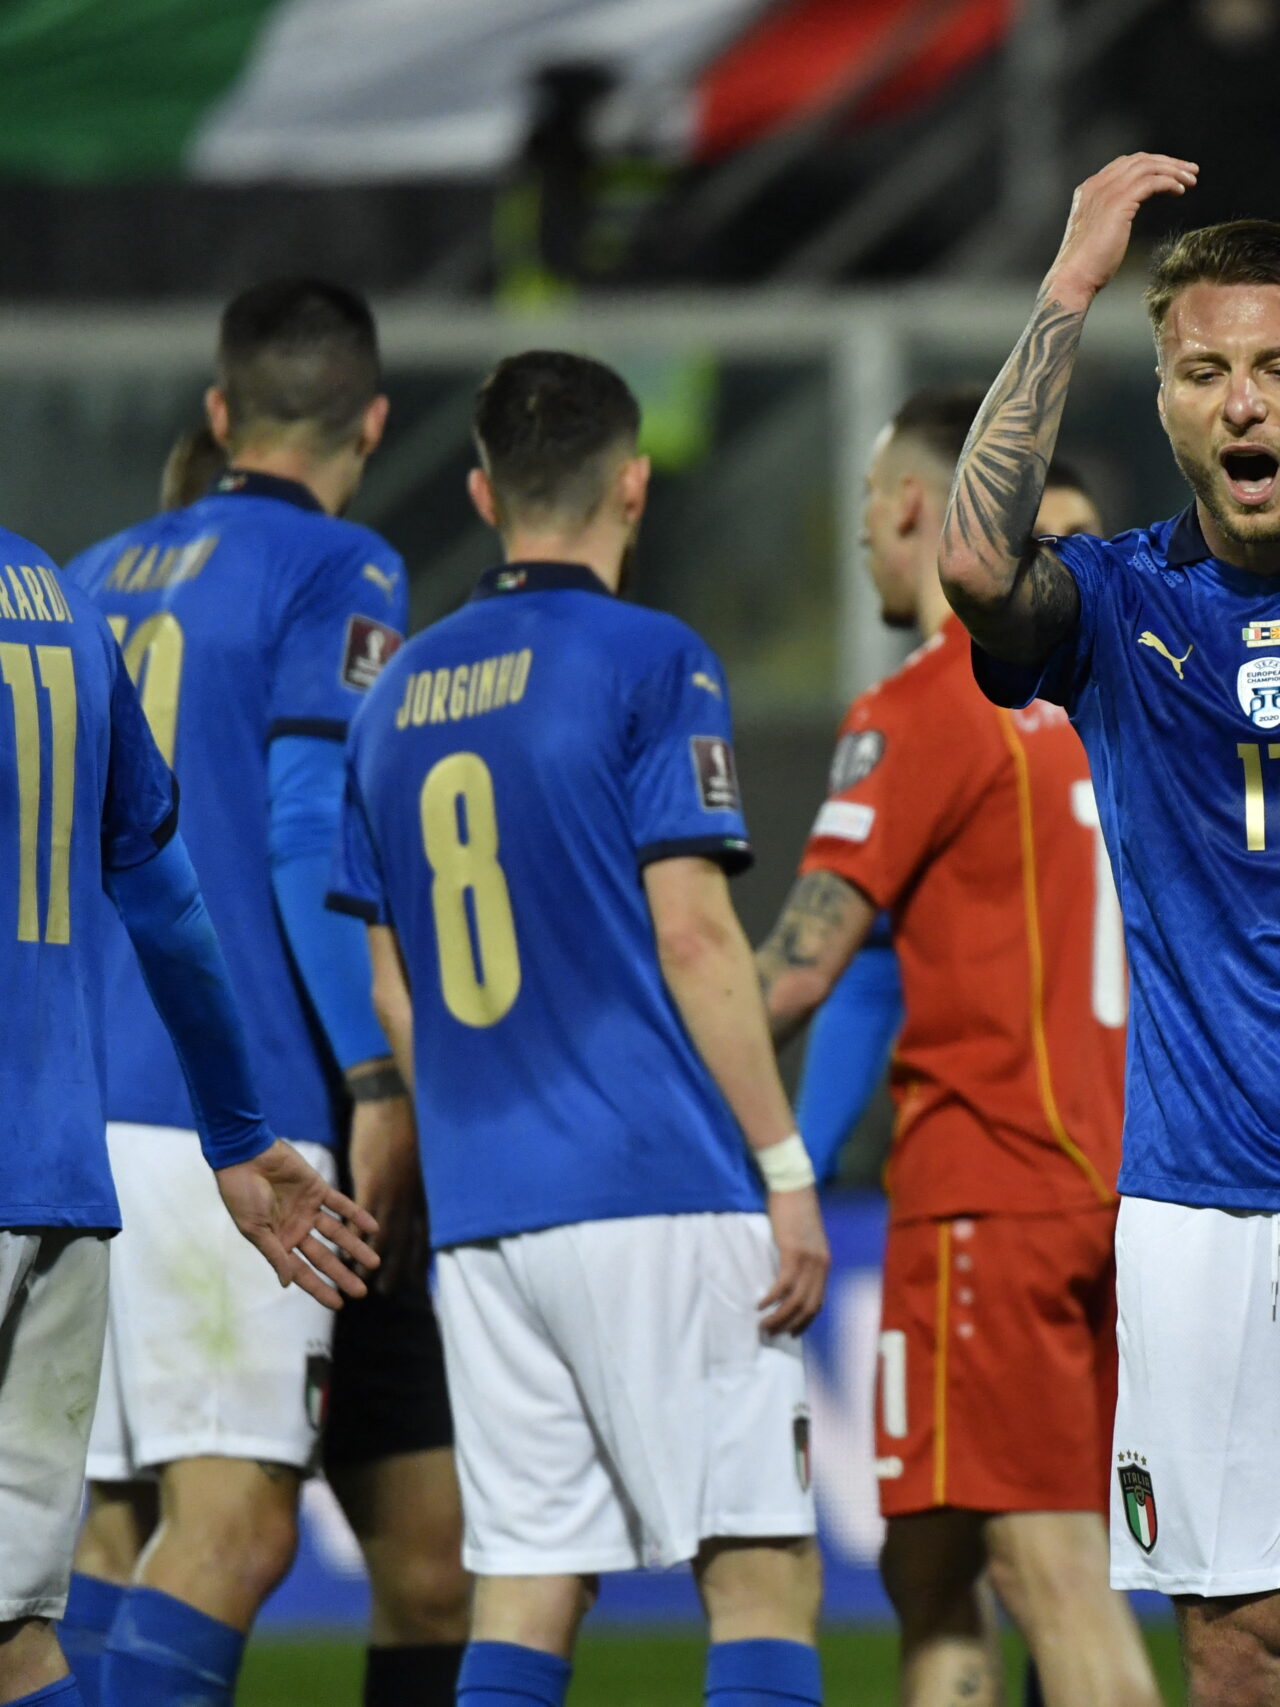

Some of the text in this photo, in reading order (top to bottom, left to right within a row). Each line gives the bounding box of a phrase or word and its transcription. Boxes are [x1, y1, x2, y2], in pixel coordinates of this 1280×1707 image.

[396, 648, 532, 731] JORGINHO
[0, 641, 78, 944] 11
[420, 752, 521, 1028] 8
[1122, 1471, 1151, 1488] ITALIA
